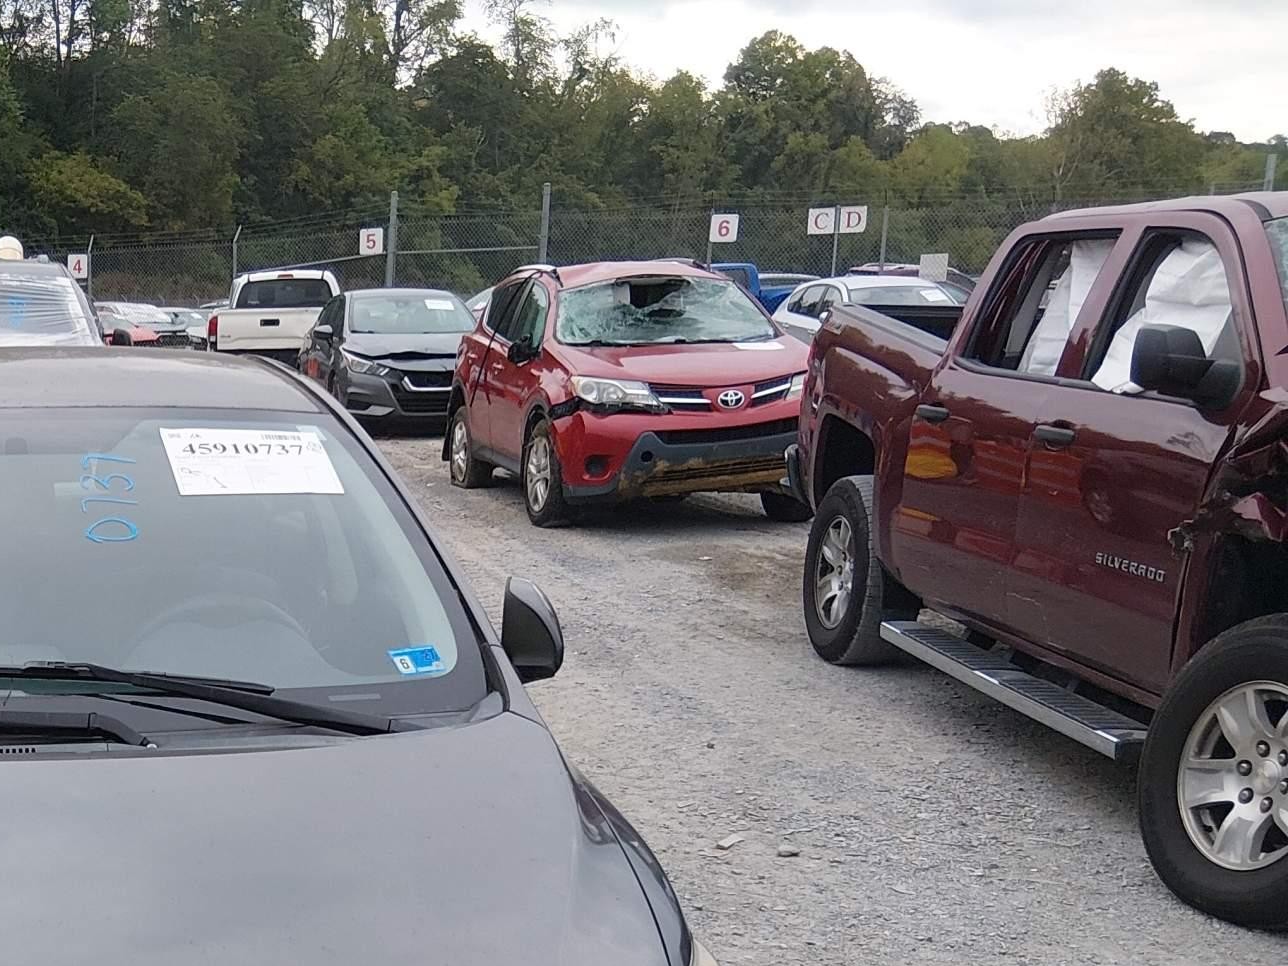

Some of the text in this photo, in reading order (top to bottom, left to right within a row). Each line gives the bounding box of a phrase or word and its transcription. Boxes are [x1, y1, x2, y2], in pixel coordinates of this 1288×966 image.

[814, 213, 829, 230] C
[846, 211, 862, 228] D
[717, 220, 730, 237] 6
[366, 233, 376, 250] 5
[73, 259, 82, 274] 4
[182, 442, 303, 455] 45910737
[1095, 552, 1166, 582] SILVERADO
[399, 658, 410, 669] 6
